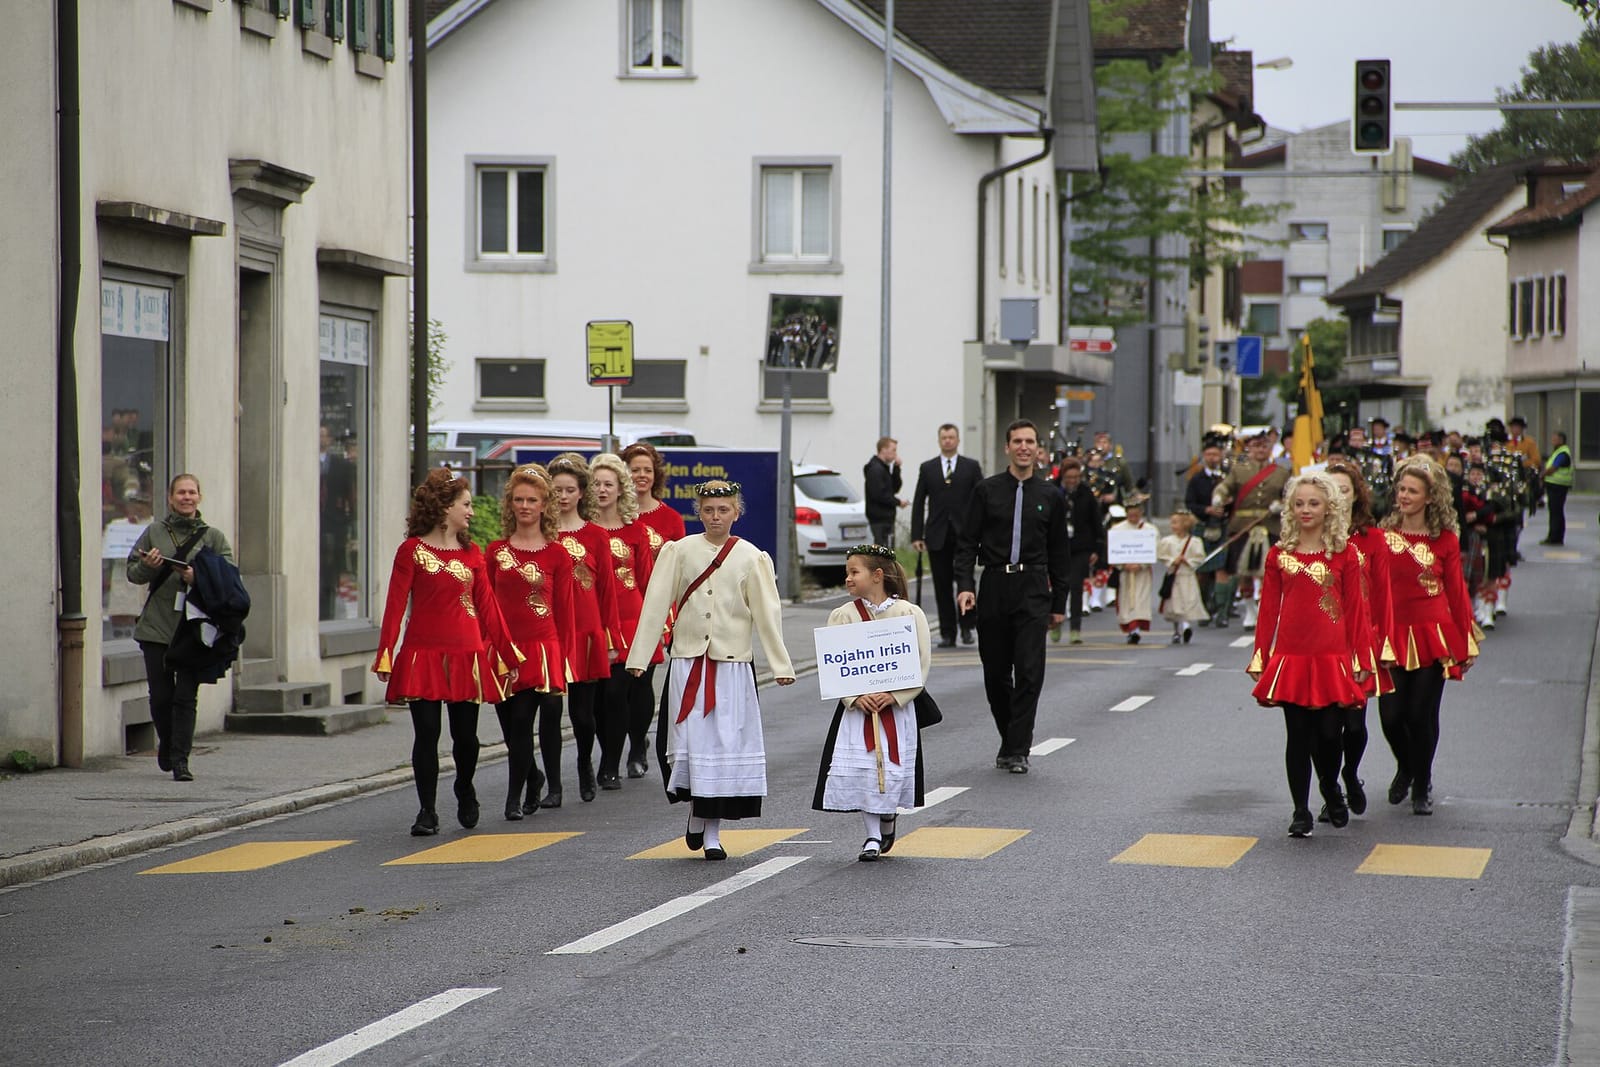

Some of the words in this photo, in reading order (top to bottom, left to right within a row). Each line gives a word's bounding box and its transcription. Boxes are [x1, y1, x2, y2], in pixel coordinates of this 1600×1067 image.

[692, 462, 728, 479] dem,
[823, 649, 875, 666] Rojahn
[880, 642, 911, 657] Irish
[840, 661, 898, 678] Dancers
